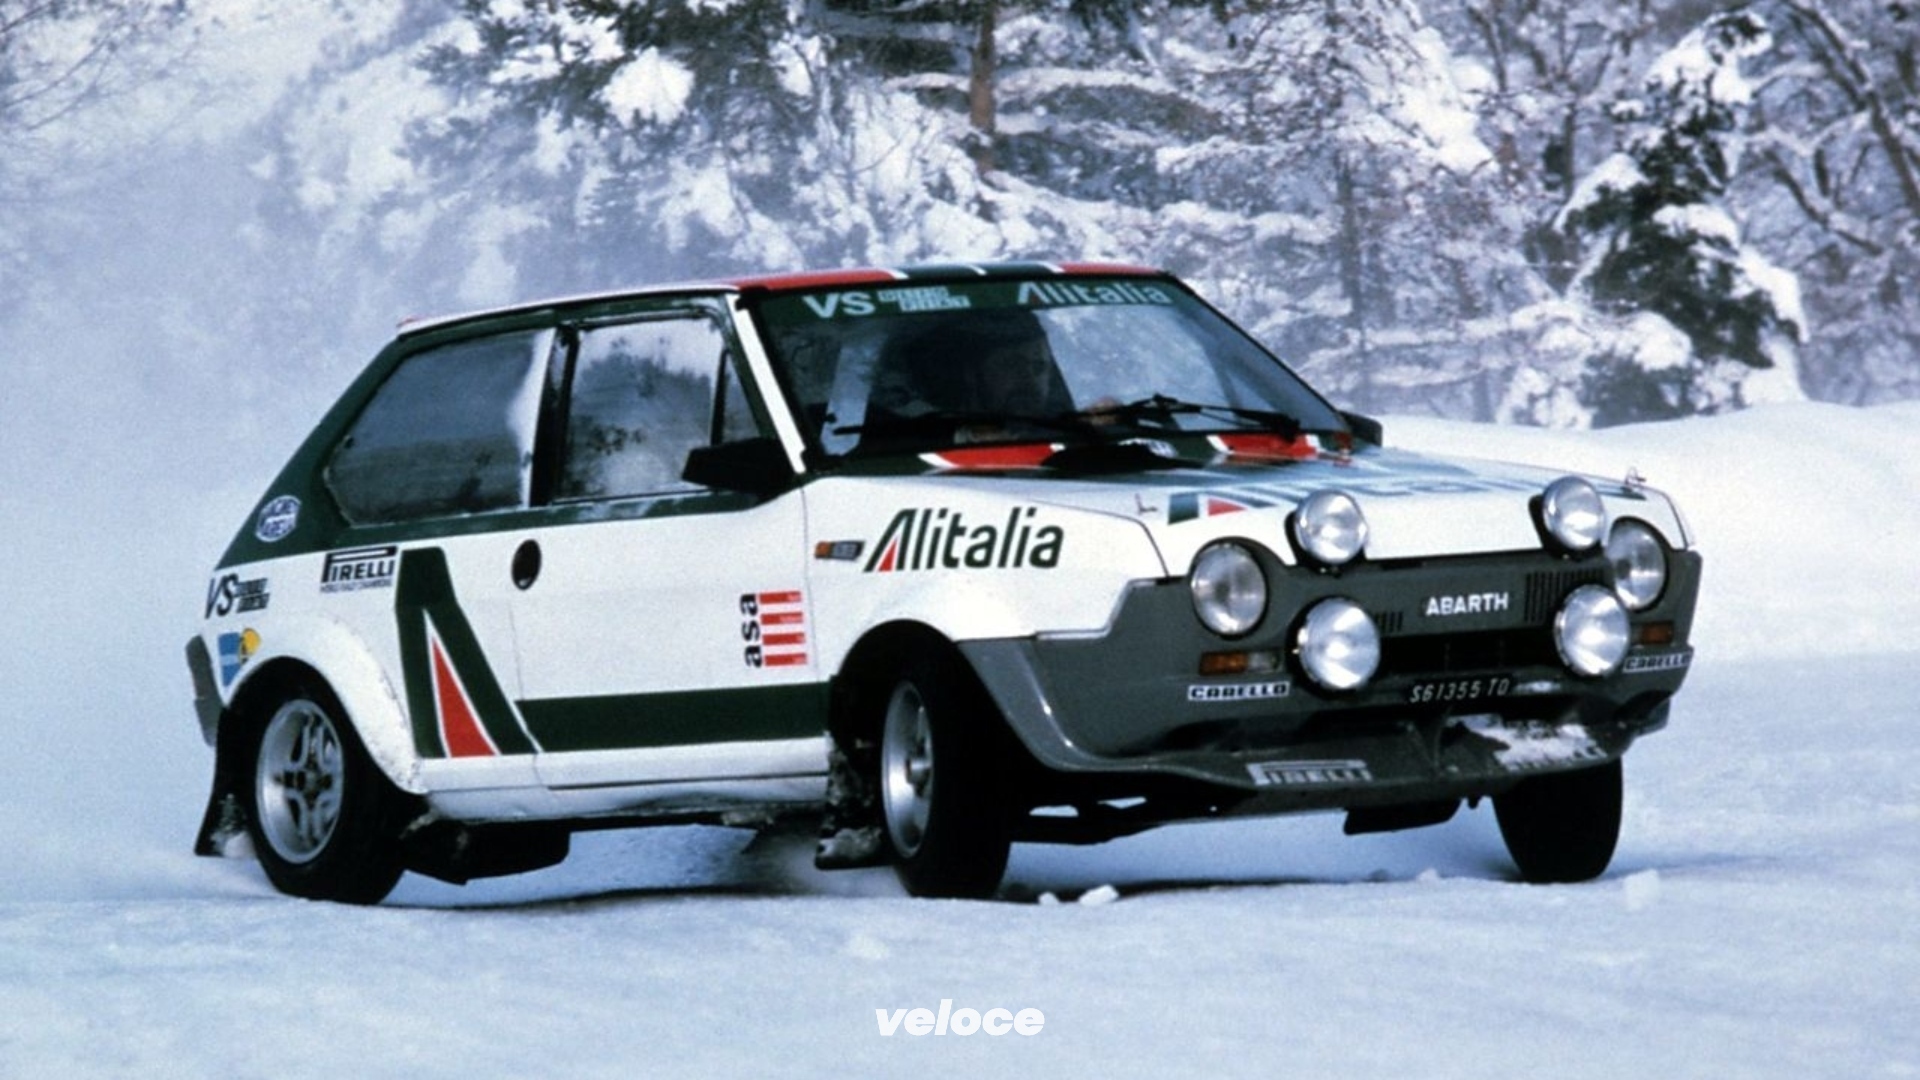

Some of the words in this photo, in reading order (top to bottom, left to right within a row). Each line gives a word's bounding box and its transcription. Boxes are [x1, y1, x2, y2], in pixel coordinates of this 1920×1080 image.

[802, 291, 876, 319] VS
[1017, 281, 1173, 305] Alitalia
[863, 506, 1065, 574] Alitalia
[321, 545, 397, 583] PIRELLI
[205, 573, 239, 619] VS
[1425, 592, 1509, 616] ABARTH
[739, 593, 762, 668] asa
[1190, 683, 1287, 699] CARELLO
[1409, 679, 1482, 703] S61355
[1246, 759, 1373, 786] PIRELLI
